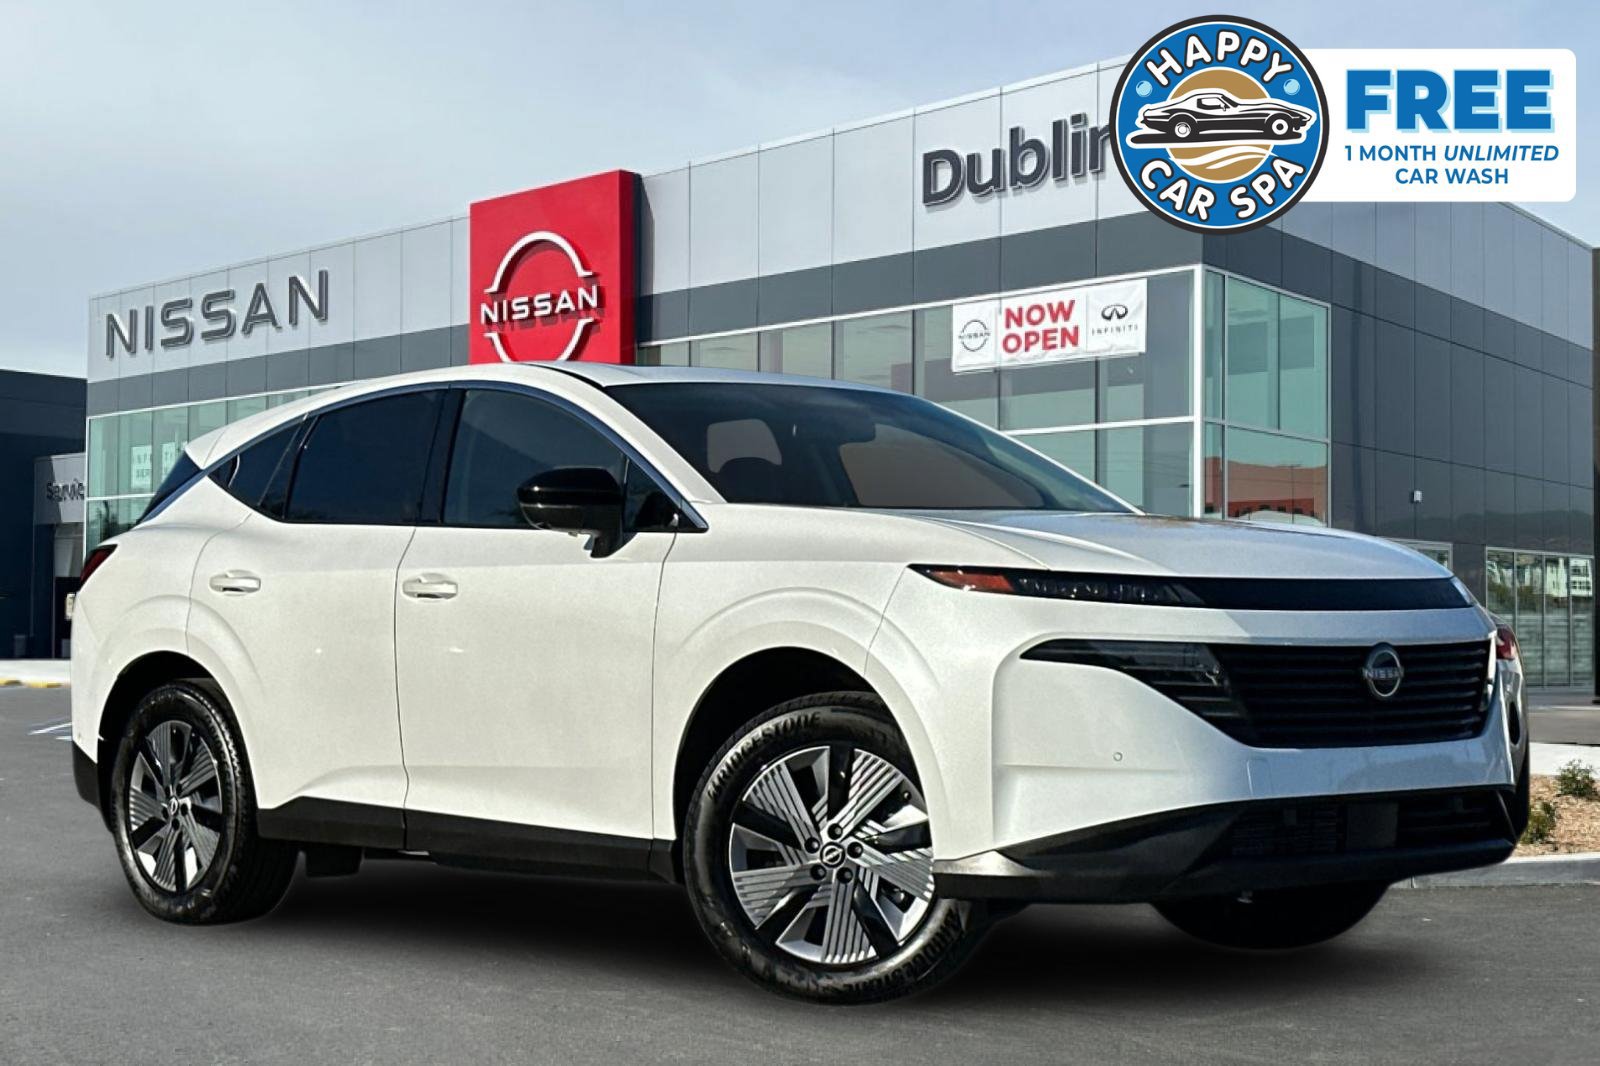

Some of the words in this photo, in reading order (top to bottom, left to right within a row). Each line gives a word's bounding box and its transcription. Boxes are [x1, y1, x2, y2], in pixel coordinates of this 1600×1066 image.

[105, 269, 329, 360] NISSAN
[480, 284, 598, 325] NISSAN
[1004, 299, 1076, 330] NOW
[1002, 325, 1080, 354] OPEN
[1091, 323, 1139, 336] INFINITI
